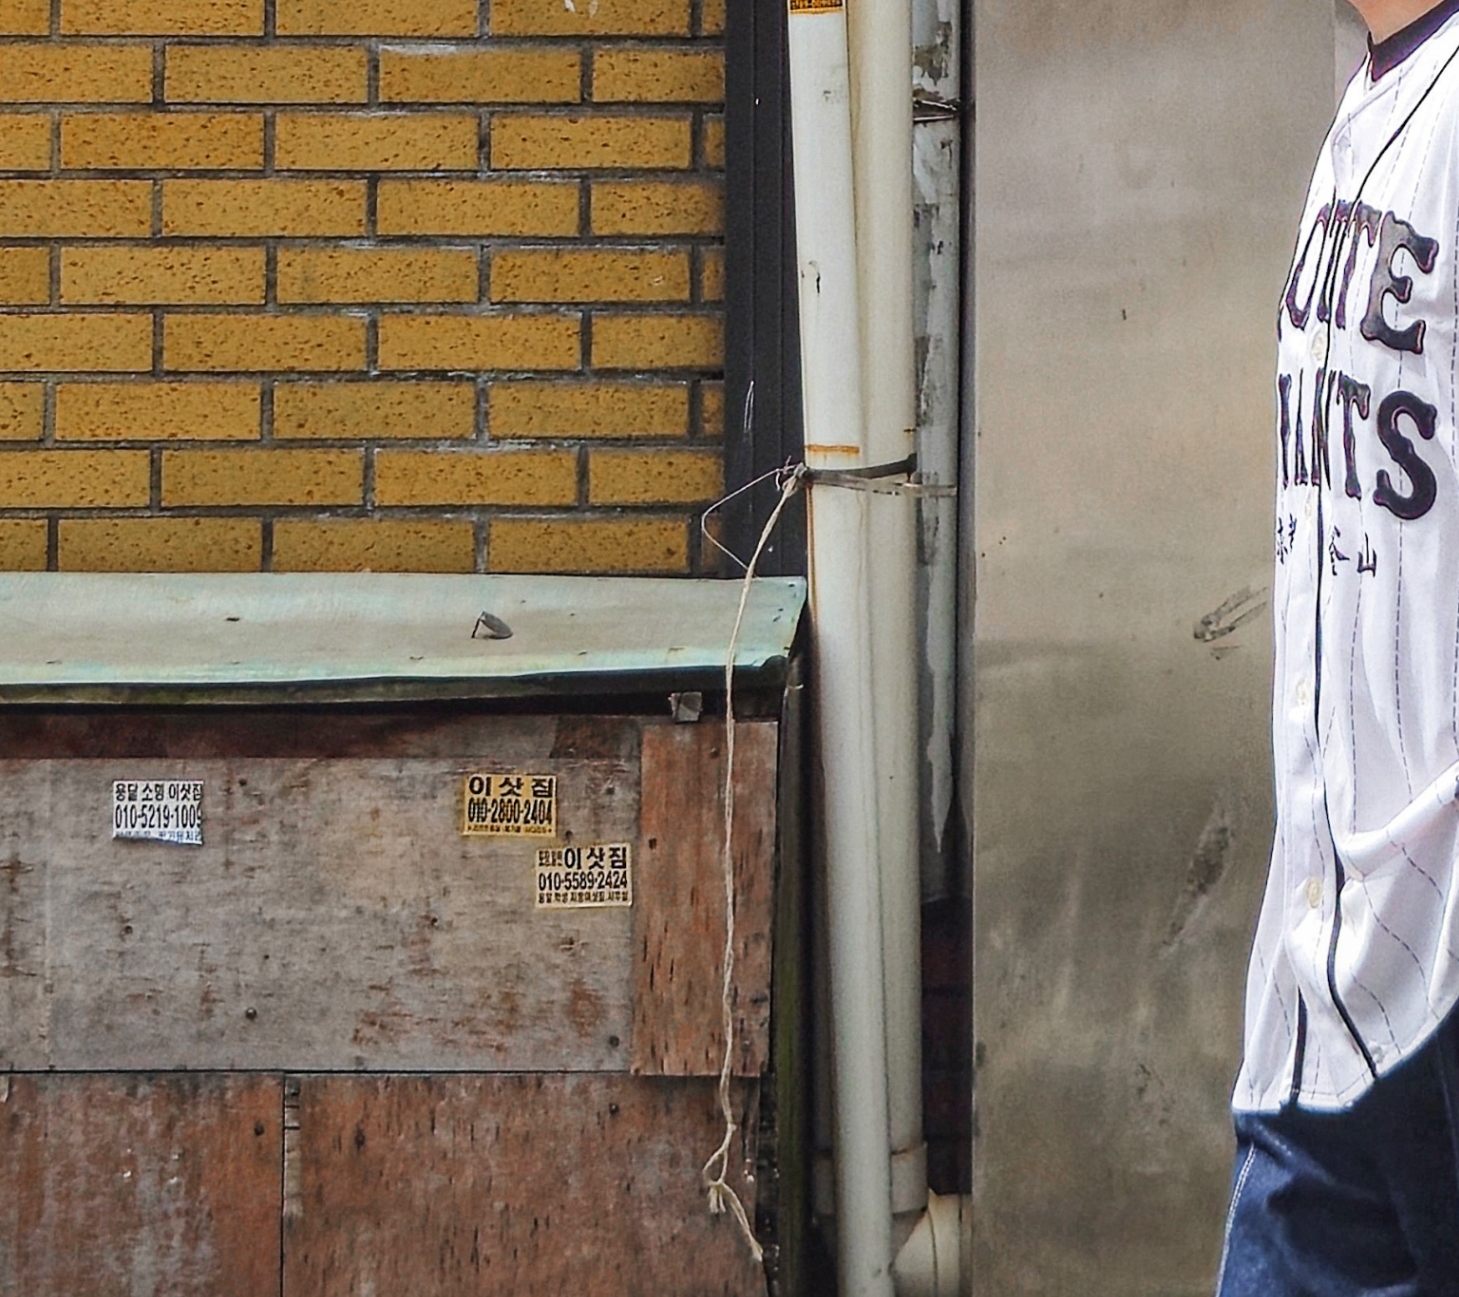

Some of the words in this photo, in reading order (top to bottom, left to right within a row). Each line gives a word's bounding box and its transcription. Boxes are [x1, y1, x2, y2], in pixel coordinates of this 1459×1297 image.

[468, 776, 553, 798] 이삿짐
[564, 846, 627, 871] 이삿짐
[538, 870, 628, 891] 010-5589-2424
